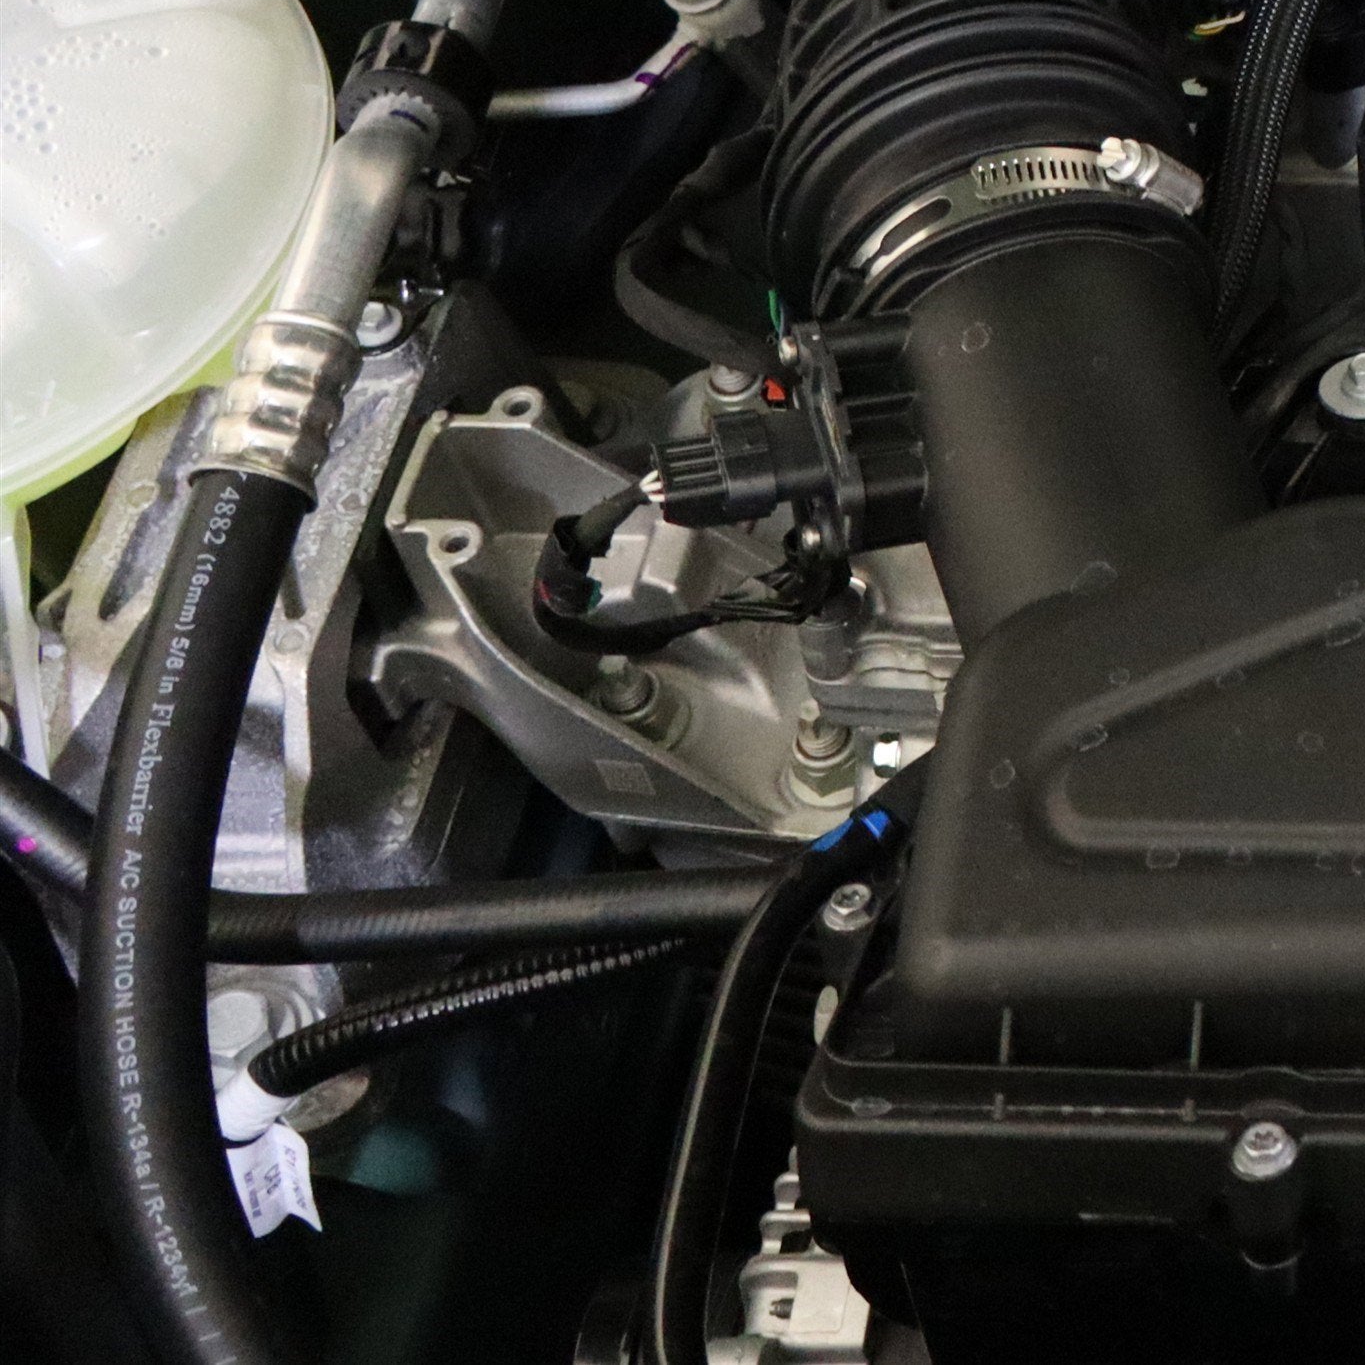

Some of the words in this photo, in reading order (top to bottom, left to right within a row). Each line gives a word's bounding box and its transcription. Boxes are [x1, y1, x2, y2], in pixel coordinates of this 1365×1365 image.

[204, 486, 240, 545] 4882
[174, 554, 216, 631] (16mm)
[158, 676, 180, 694] in
[166, 637, 190, 670] 5/8
[126, 702, 175, 836] Flexbarrier
[120, 848, 143, 890] A/C
[114, 896, 138, 1010] SUCTION
[114, 1015, 140, 1088] HOSE
[122, 1092, 152, 1180] R-134a
